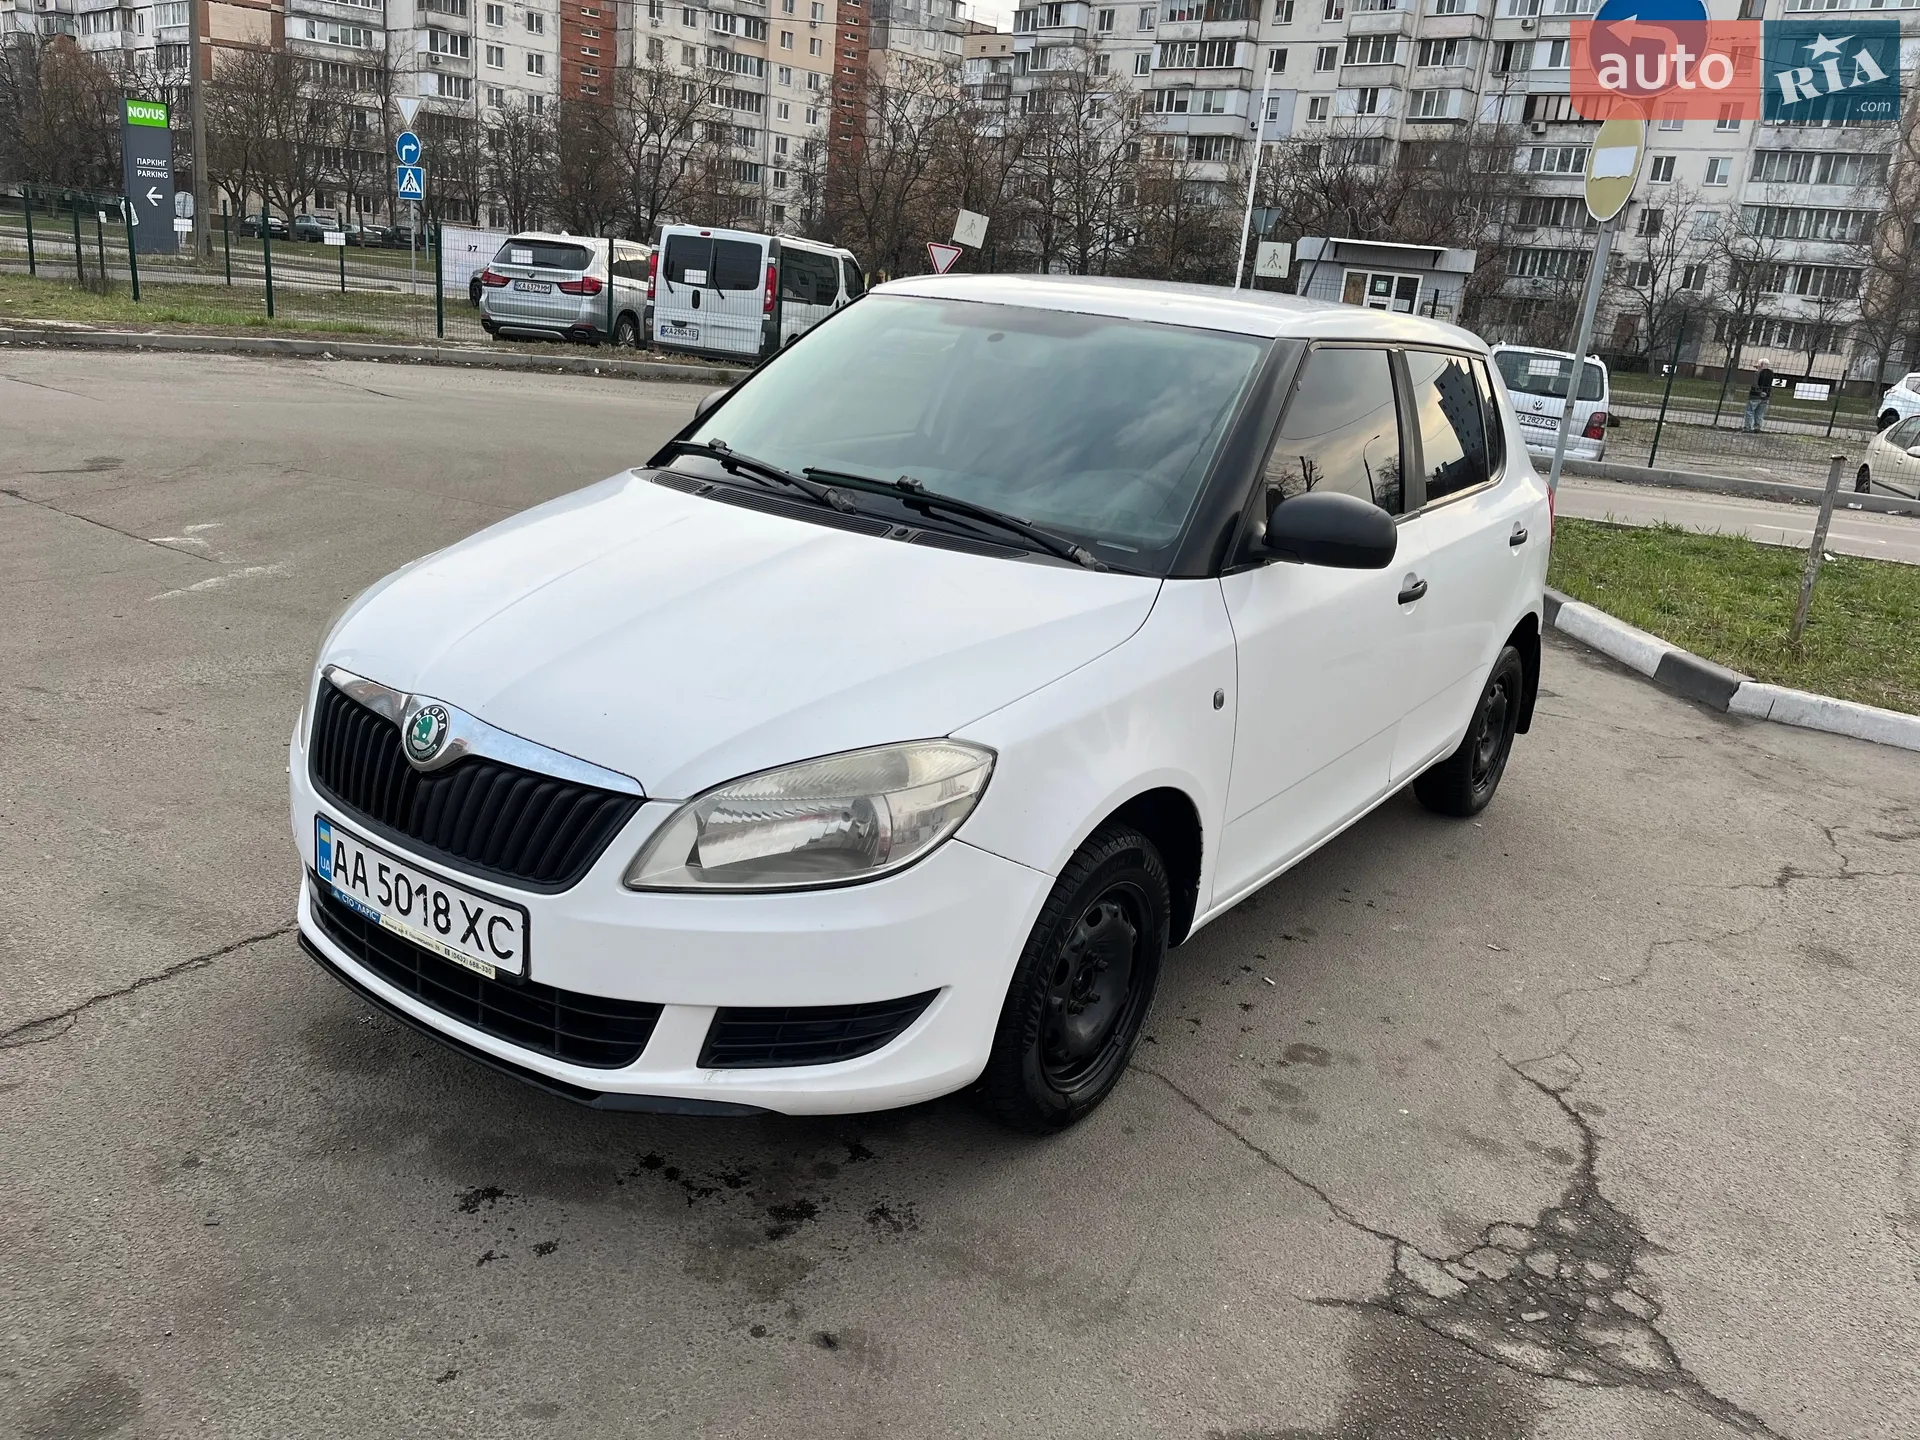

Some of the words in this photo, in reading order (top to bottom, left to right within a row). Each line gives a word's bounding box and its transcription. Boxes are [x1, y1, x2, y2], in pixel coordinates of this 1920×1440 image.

[128, 106, 165, 120] NOVUS
[136, 157, 167, 167] ПАРКІНГ
[137, 169, 169, 179] PARKING
[1527, 416, 1545, 424] 2827
[320, 855, 331, 871] UA
[333, 840, 369, 898] AA
[377, 861, 451, 935] 5018
[459, 899, 514, 960] XC
